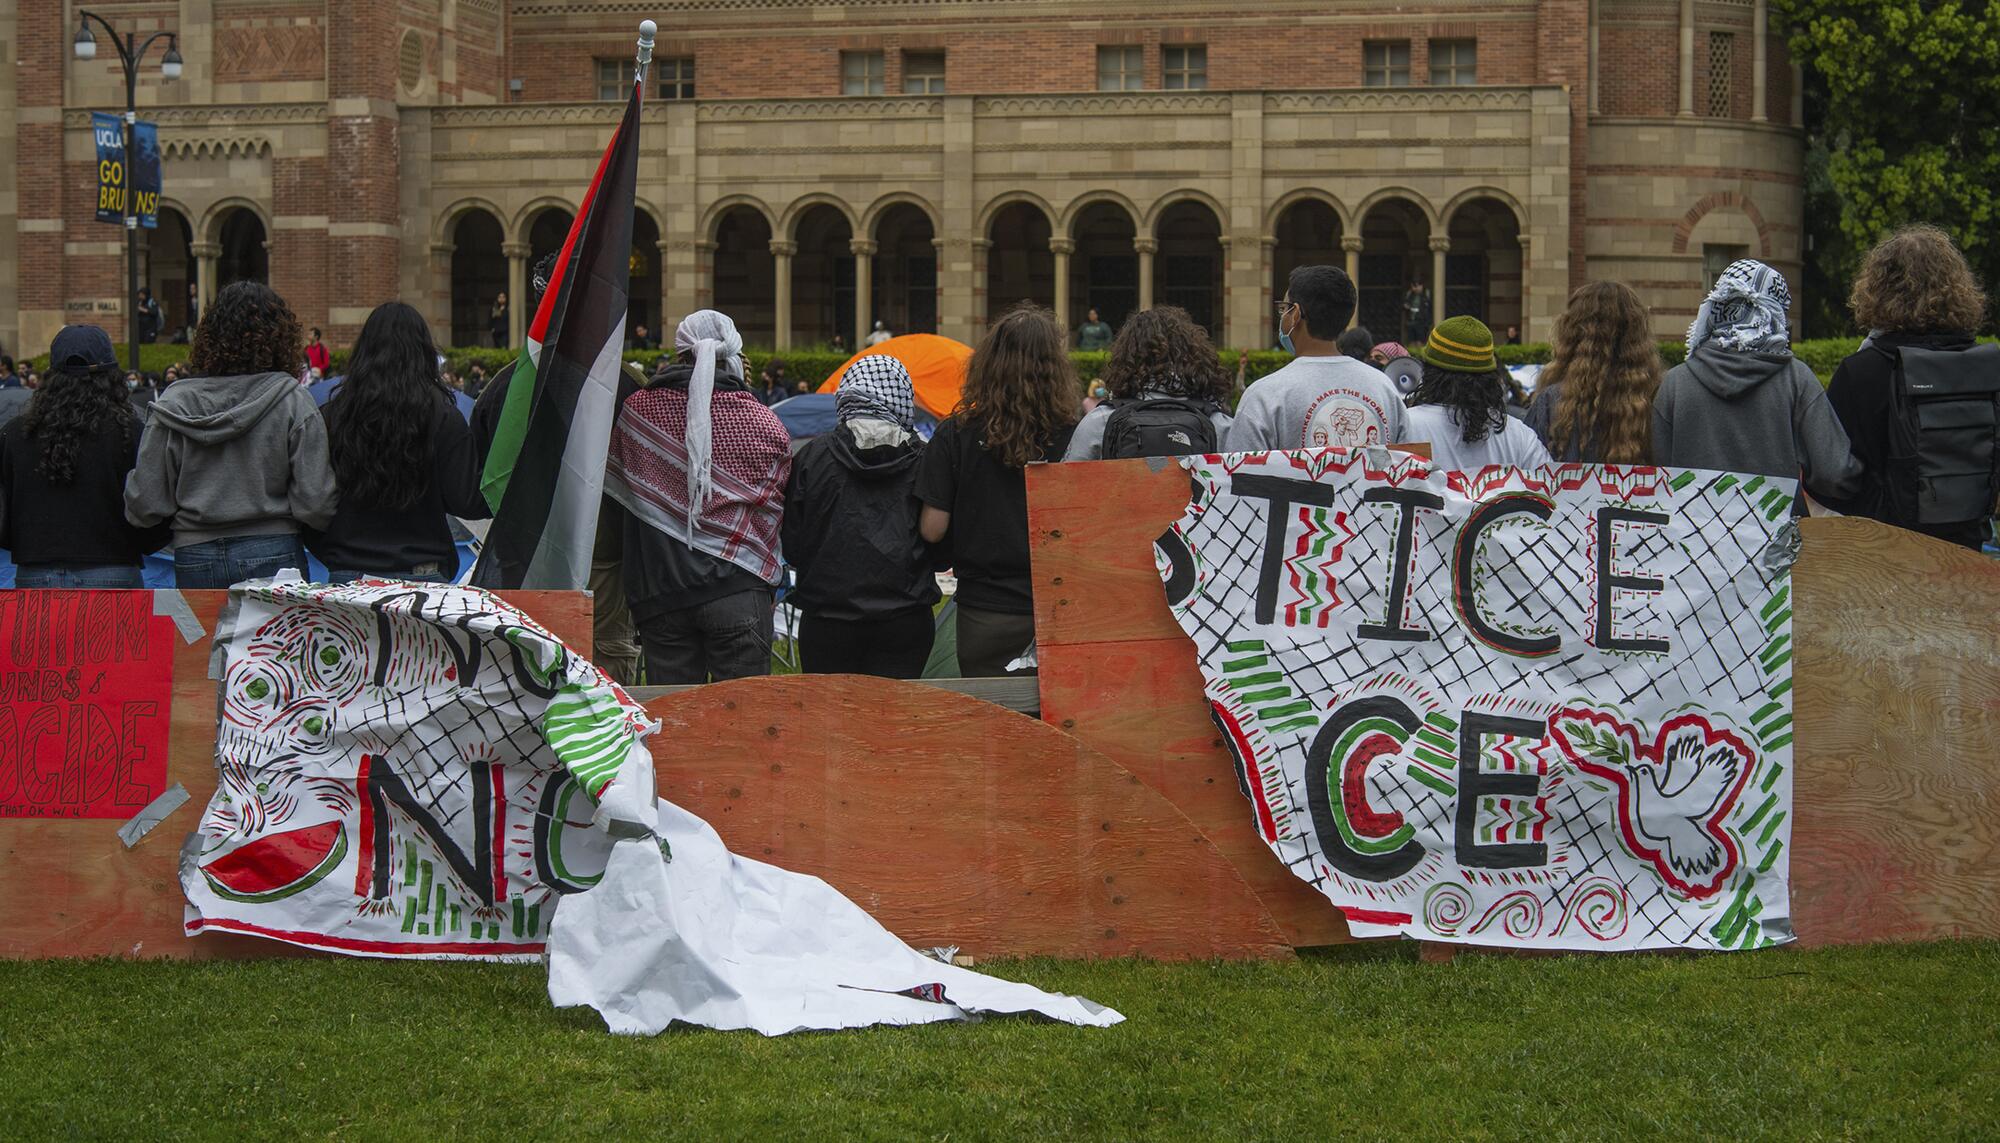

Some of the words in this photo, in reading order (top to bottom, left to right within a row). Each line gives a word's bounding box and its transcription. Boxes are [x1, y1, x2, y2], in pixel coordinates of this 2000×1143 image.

[96, 129, 122, 148] UCLA
[100, 160, 122, 185] GO
[99, 185, 159, 215] BRUNS!
[1316, 388, 1340, 403] MAKE
[1342, 388, 1360, 398] THE
[1362, 395, 1387, 425] WORLD
[1211, 695, 1550, 882] CE
[29, 805, 45, 817] OK
